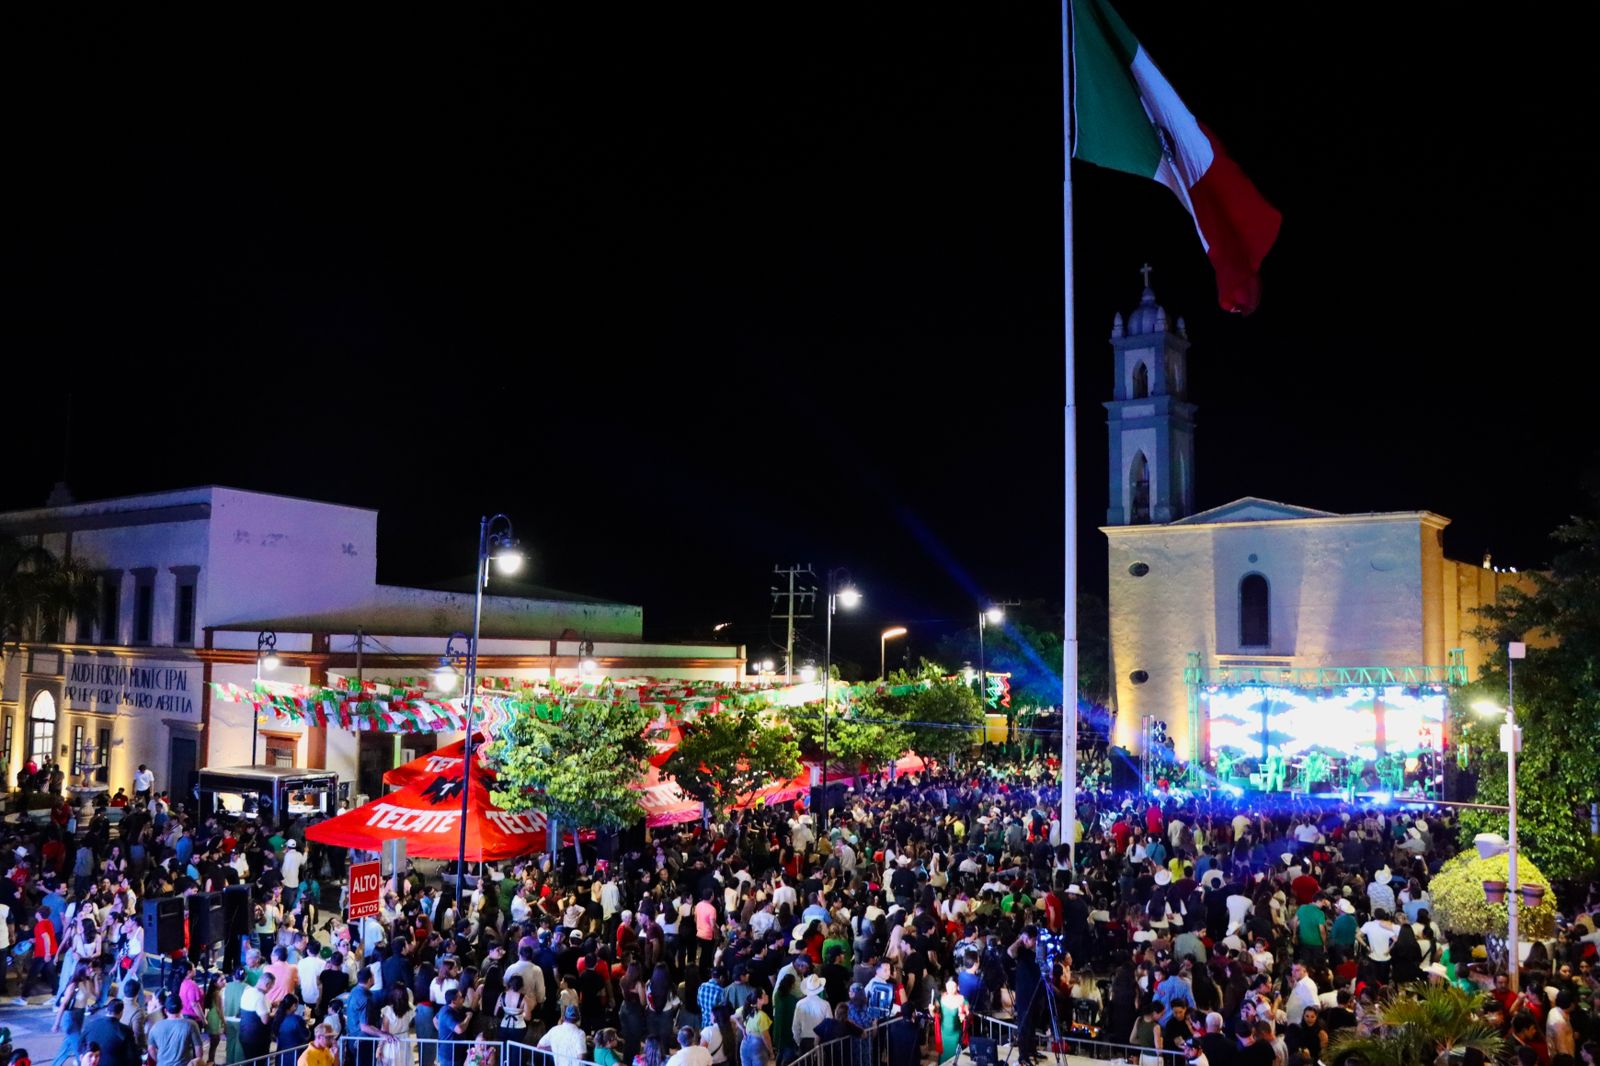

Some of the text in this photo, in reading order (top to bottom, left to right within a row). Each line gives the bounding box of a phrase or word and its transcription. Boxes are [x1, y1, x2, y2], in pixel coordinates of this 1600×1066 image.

[71, 664, 189, 691] AUDITORIO MUNICIPAL
[156, 696, 192, 713] ABITIA
[366, 802, 468, 833] TECATE
[485, 808, 548, 835] TECA
[352, 873, 378, 894] ALTO
[357, 903, 378, 914] ALTOS
